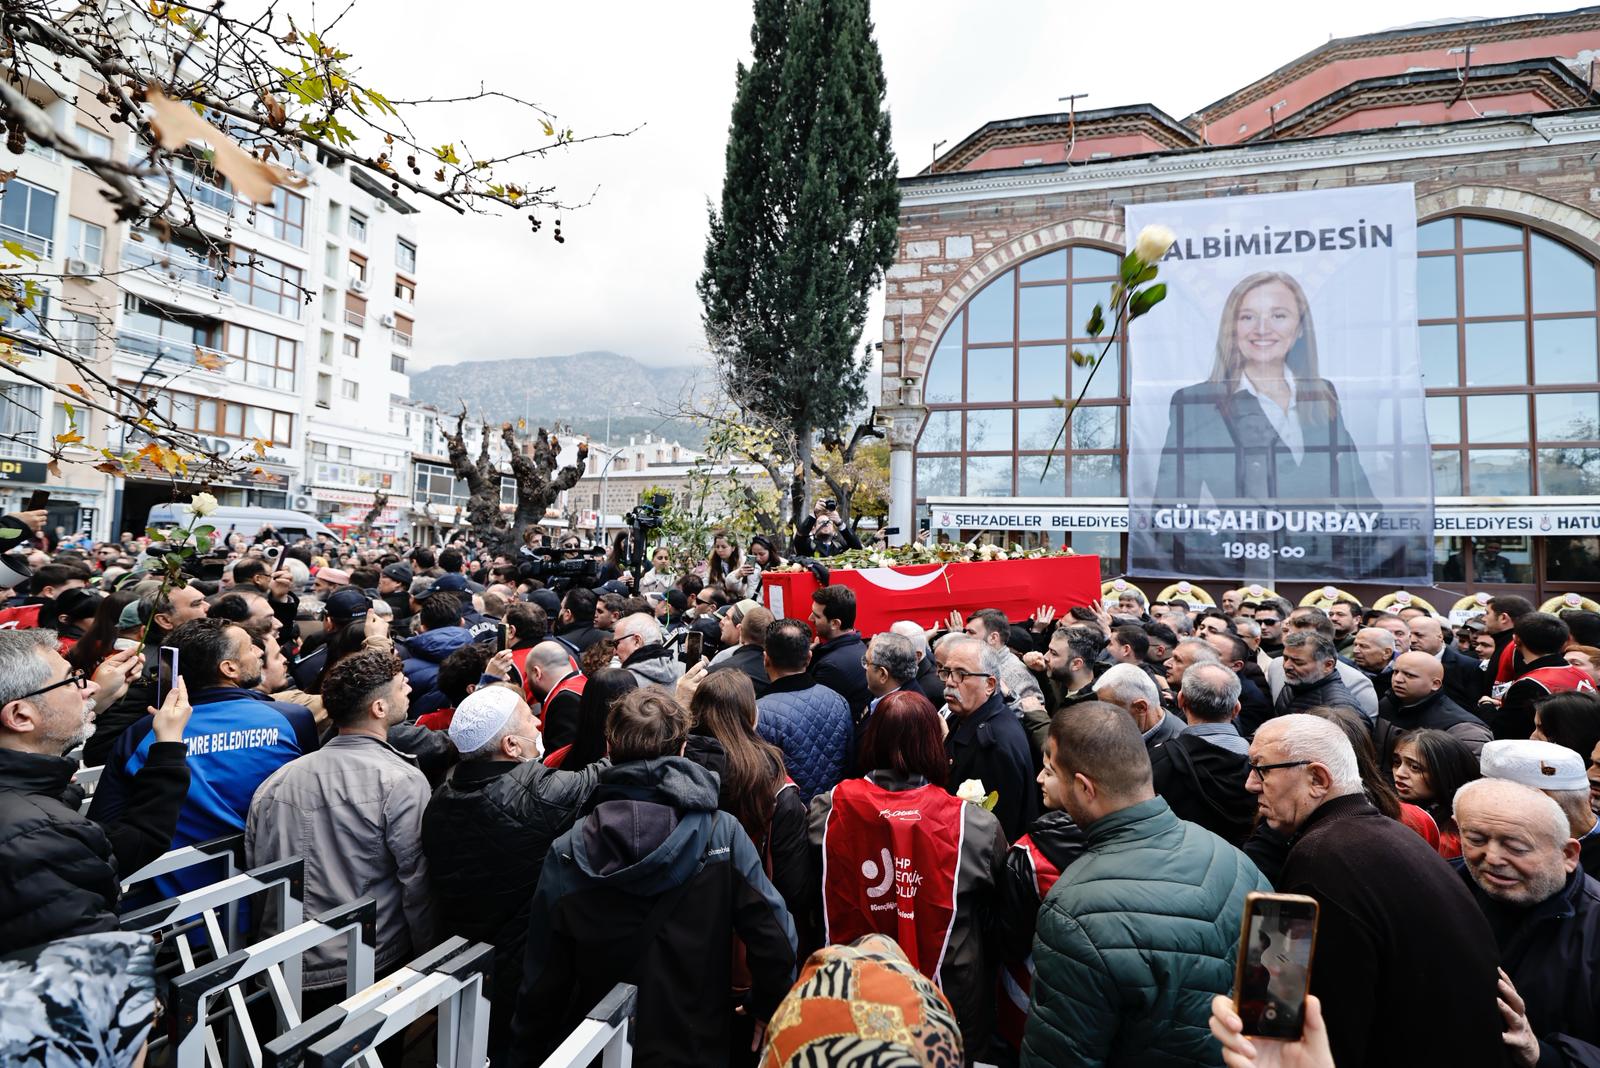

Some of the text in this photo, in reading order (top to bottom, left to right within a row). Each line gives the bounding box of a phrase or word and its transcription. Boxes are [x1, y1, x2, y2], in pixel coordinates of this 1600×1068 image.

[1160, 219, 1394, 262] ALBİMİZDESİN
[955, 514, 1042, 527] ŞEHZADELER
[1155, 503, 1379, 536] GÜLŞAH DURBAY
[181, 734, 210, 757] EMRE
[707, 846, 731, 856] olumbia
[895, 857, 911, 869] HP
